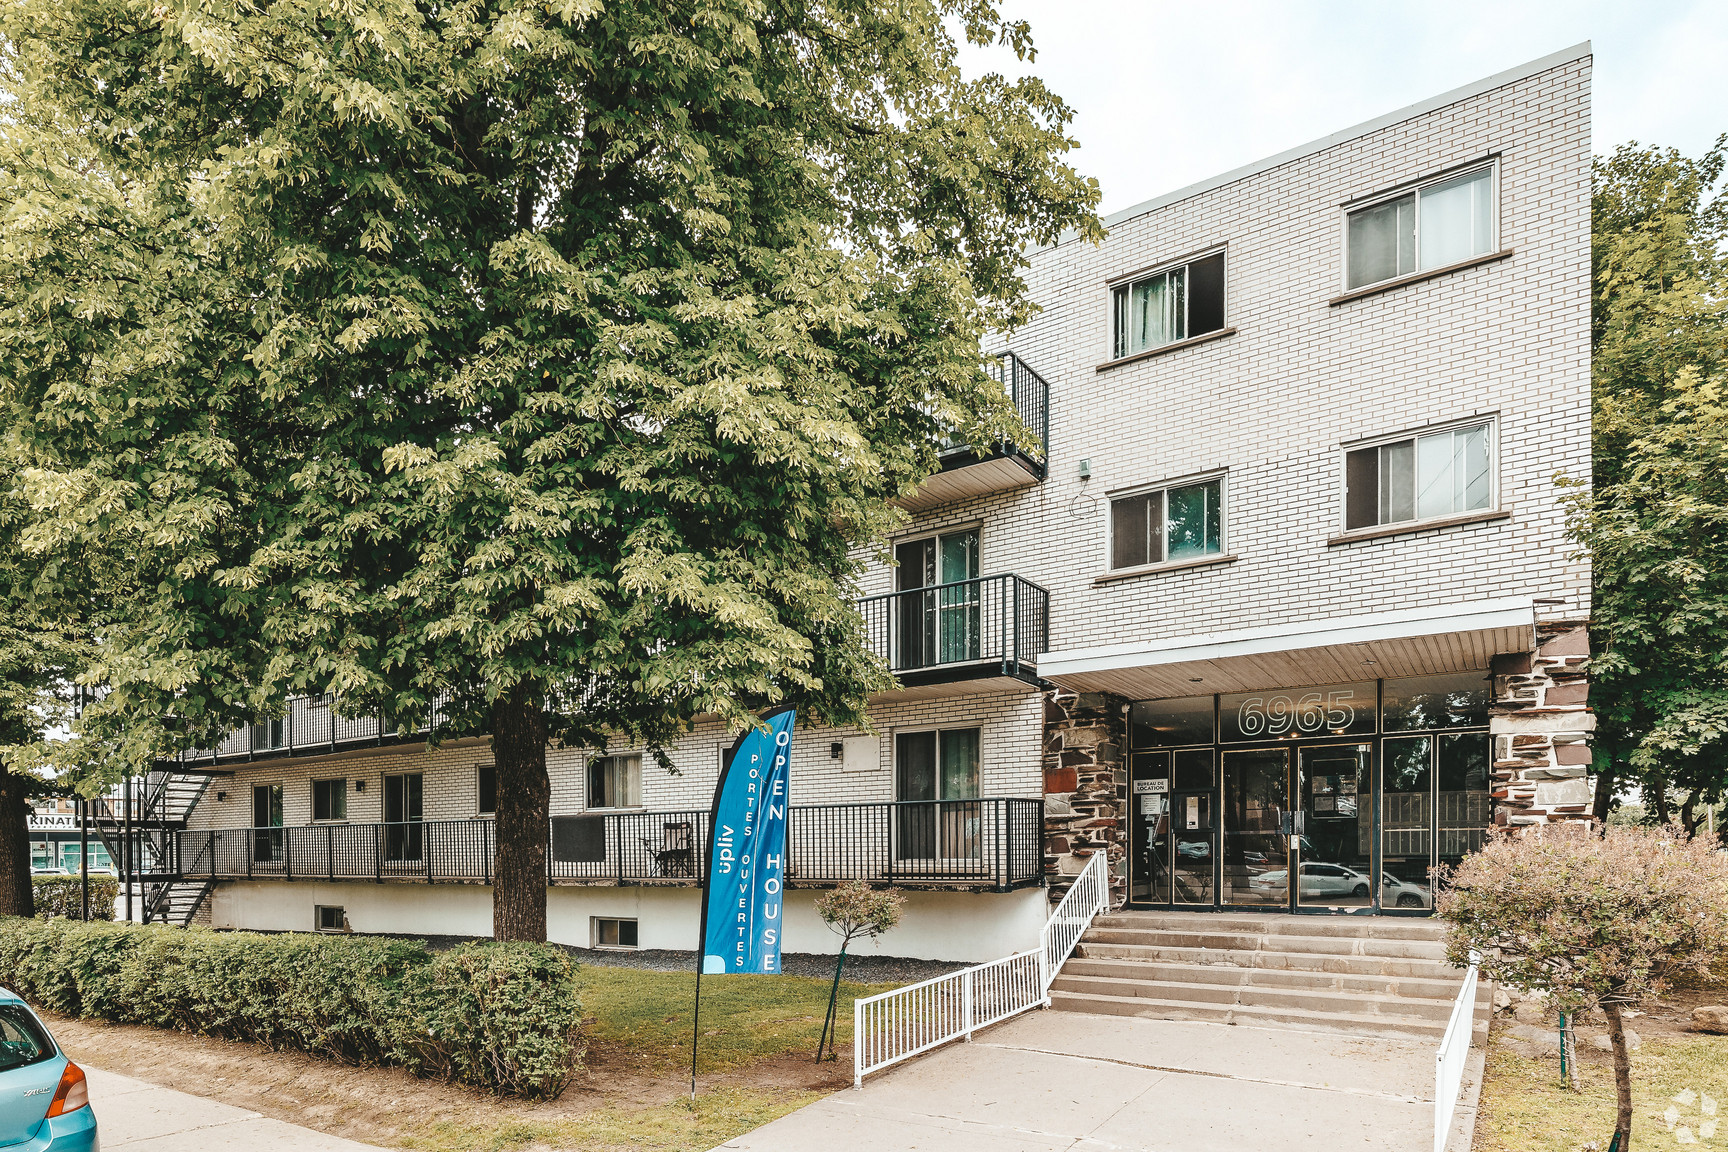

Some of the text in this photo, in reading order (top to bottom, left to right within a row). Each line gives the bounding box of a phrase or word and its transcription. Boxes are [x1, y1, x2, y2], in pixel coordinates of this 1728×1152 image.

[1238, 690, 1355, 736] 6965
[30, 816, 75, 825] KINAT
[735, 754, 759, 967] PORTES OUVERTES
[763, 730, 790, 971] OPEN HOUSE
